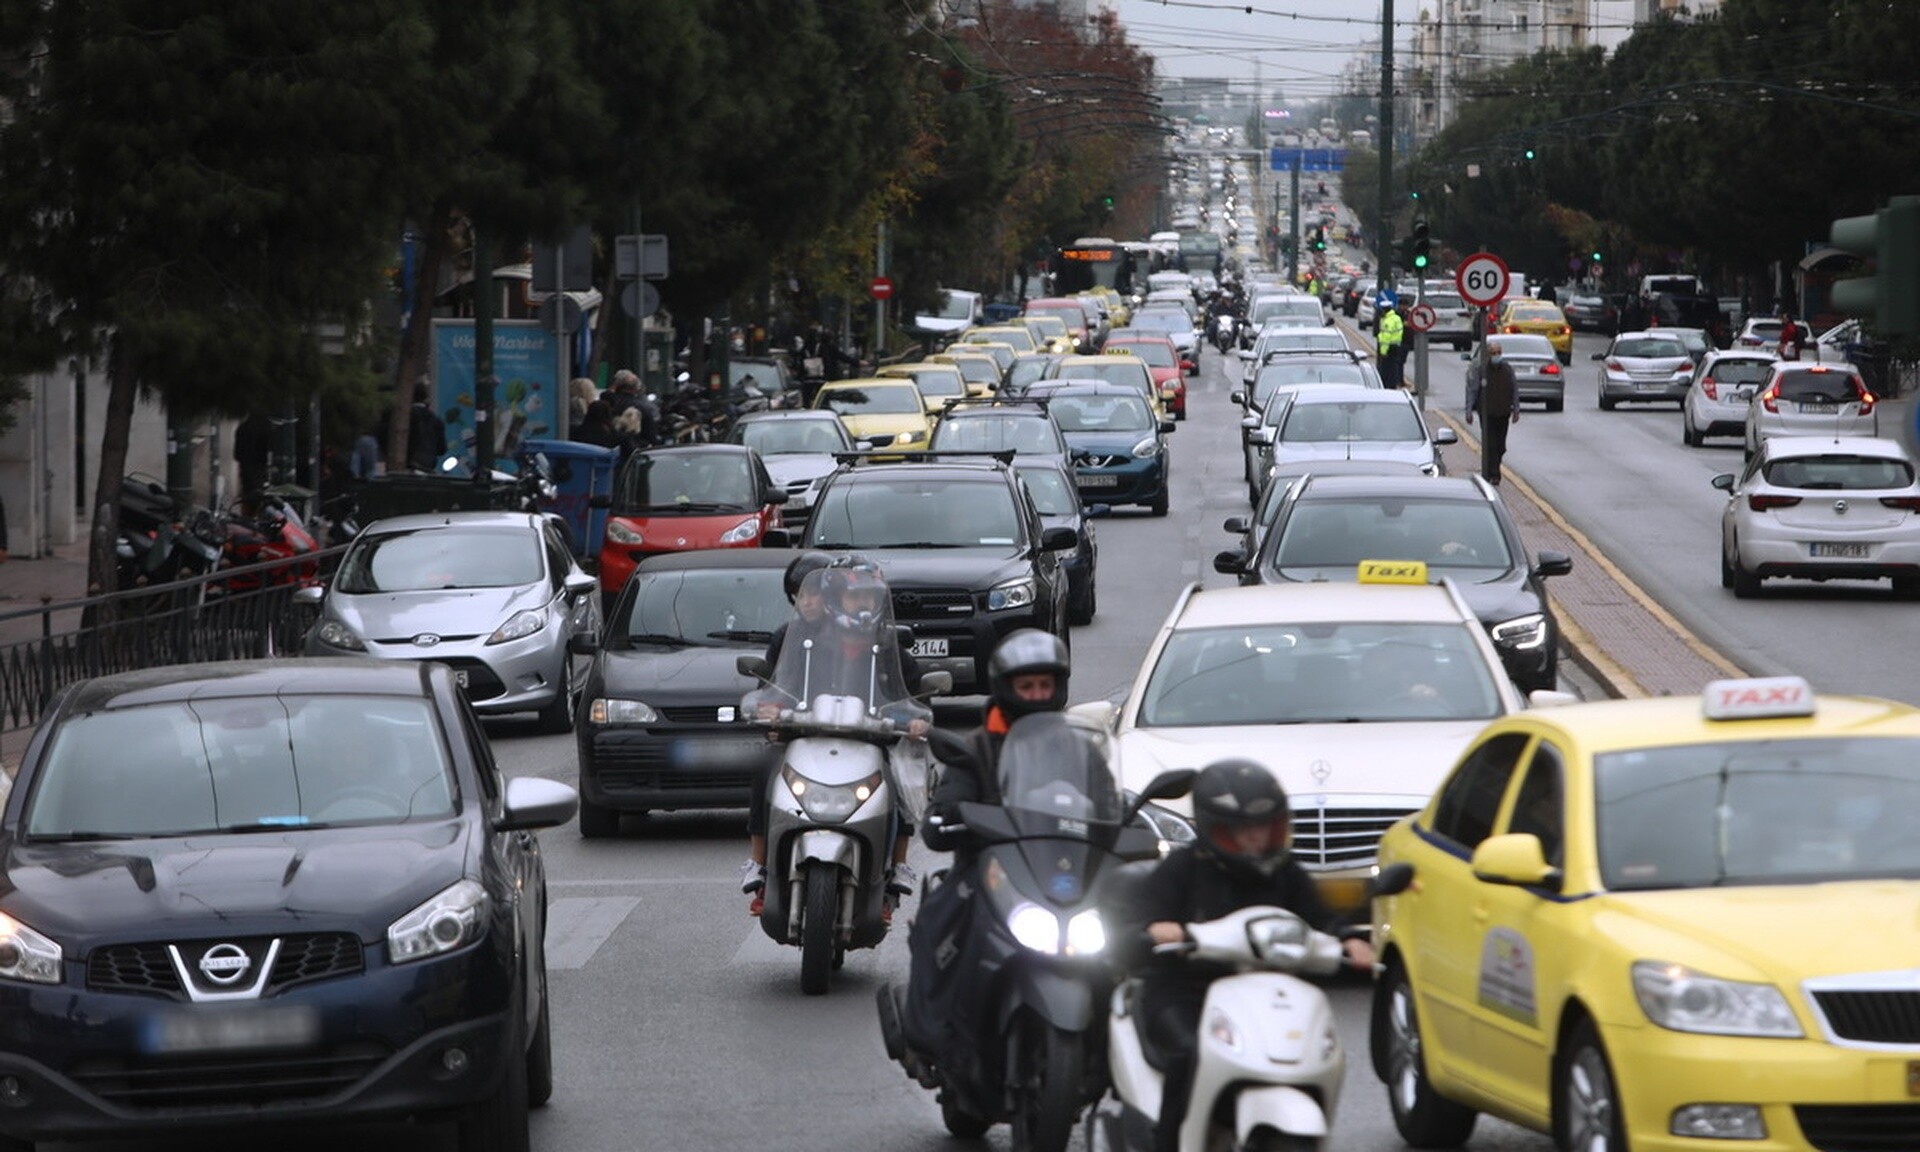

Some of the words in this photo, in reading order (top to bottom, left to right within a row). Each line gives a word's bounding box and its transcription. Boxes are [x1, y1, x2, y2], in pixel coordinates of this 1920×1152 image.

[1468, 269, 1498, 291] 60
[1366, 564, 1419, 577] Taxi
[911, 640, 947, 656] 8144
[1719, 687, 1804, 707] TAXI
